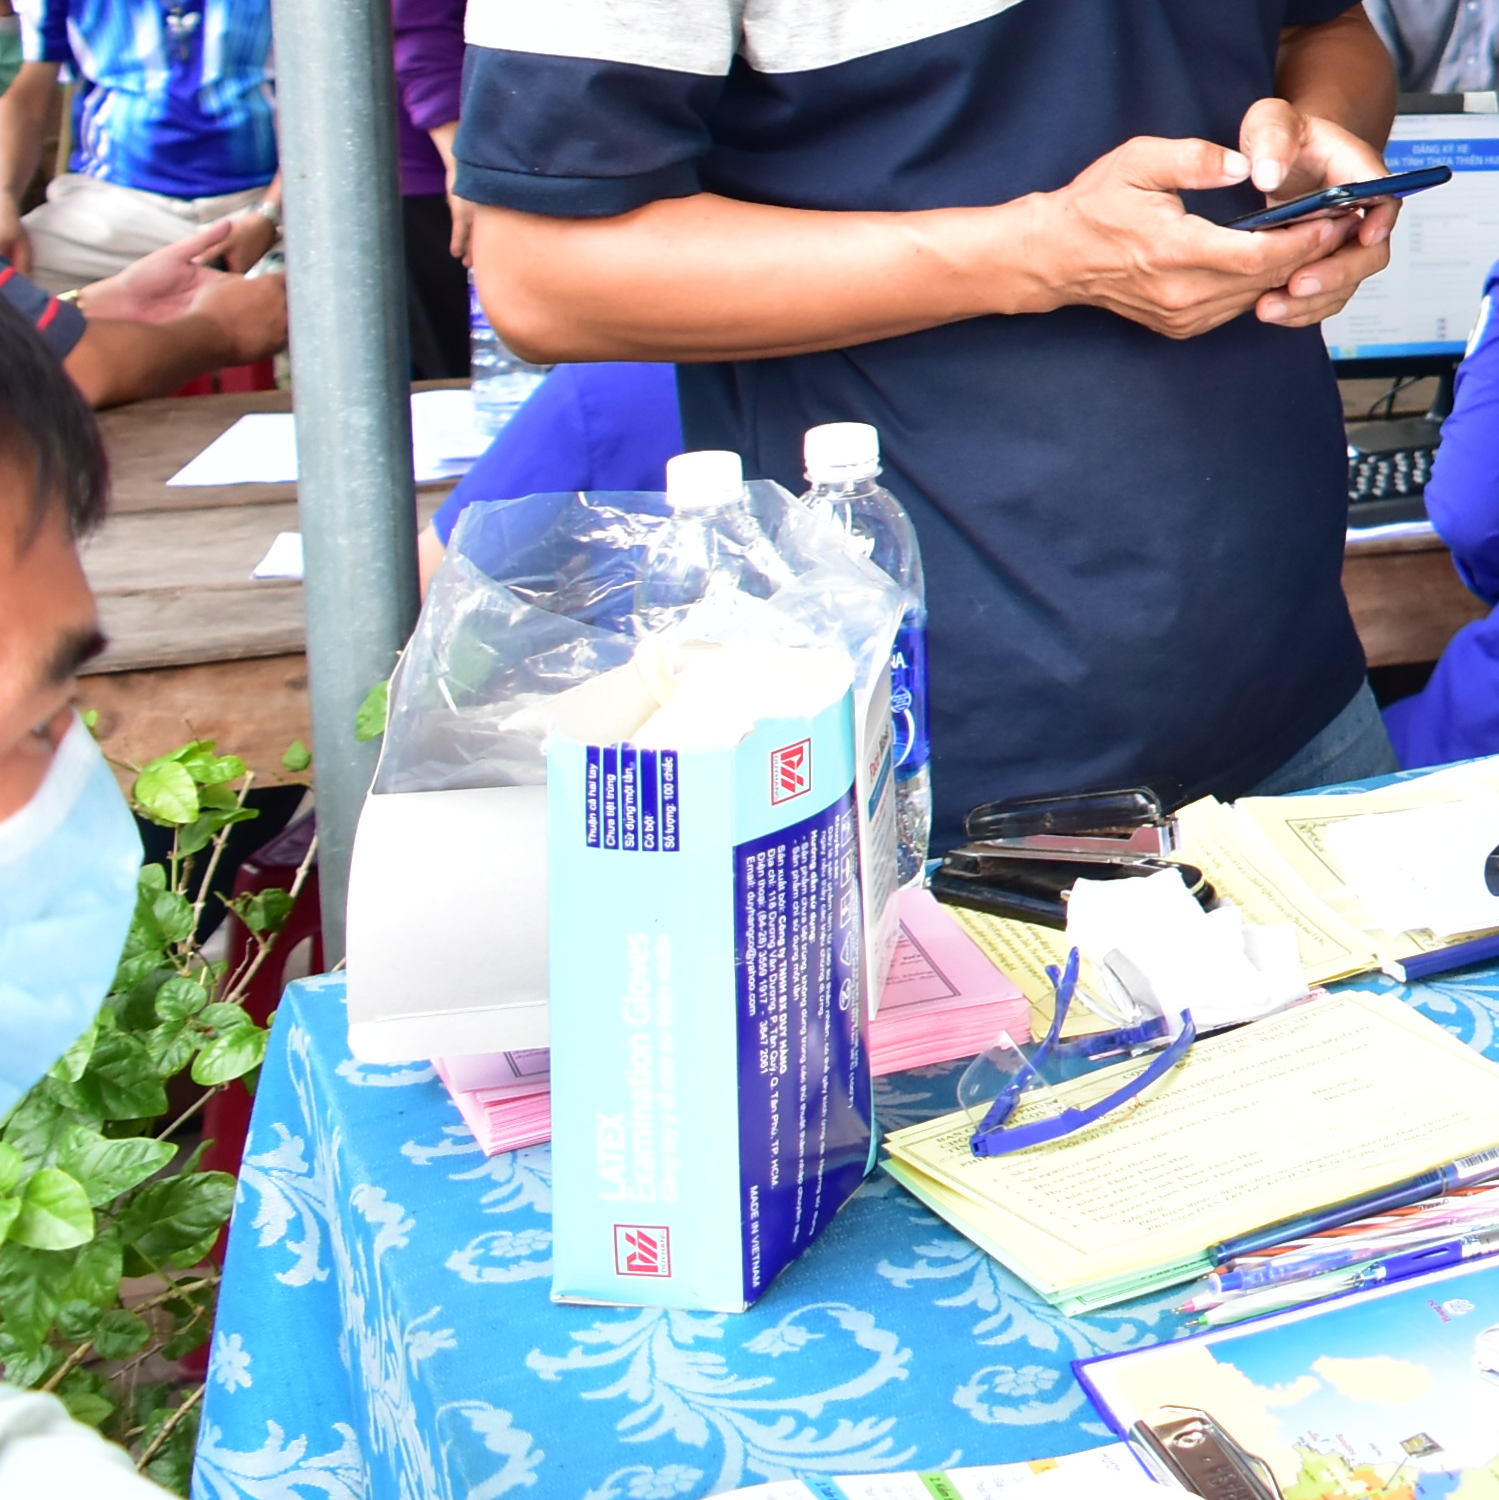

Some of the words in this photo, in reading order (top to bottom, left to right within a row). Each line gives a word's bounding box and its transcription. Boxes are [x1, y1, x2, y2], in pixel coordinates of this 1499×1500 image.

[587, 763, 598, 779] tay
[661, 756, 673, 782] chiếc
[587, 781, 597, 797] hai
[605, 773, 617, 800] trùng
[624, 784, 635, 804] một
[664, 783, 674, 801] 100
[625, 805, 636, 831] dụng
[644, 815, 656, 832] bột
[605, 818, 615, 847] Chưa
[644, 833, 654, 849] Có
[662, 835, 675, 849] Số
[746, 855, 756, 890] Email:
[768, 889, 777, 910] 118
[756, 910, 767, 949] (84-28)
[777, 914, 787, 947] Công
[745, 891, 757, 1017] duyhangco@yahoo.com
[757, 949, 768, 977] 3559
[776, 947, 786, 958] ty
[620, 931, 652, 1029] Gloves
[778, 959, 787, 994] TNHH
[759, 979, 768, 1004] 1917
[778, 994, 787, 1012] SX
[759, 1019, 768, 1045] 3847
[769, 1026, 778, 1049] Tân
[778, 1012, 788, 1038] DUY
[759, 1048, 769, 1075] 2061
[779, 1038, 789, 1075] HÀNG
[770, 1091, 779, 1113] Tân
[624, 1032, 657, 1204] Examination
[595, 1111, 627, 1203] LATEX
[770, 1139, 779, 1158] TP.
[770, 1158, 779, 1190] HCM.
[749, 1184, 759, 1220] MADE
[750, 1221, 759, 1235] IN
[751, 1234, 761, 1288] VIETNAM
